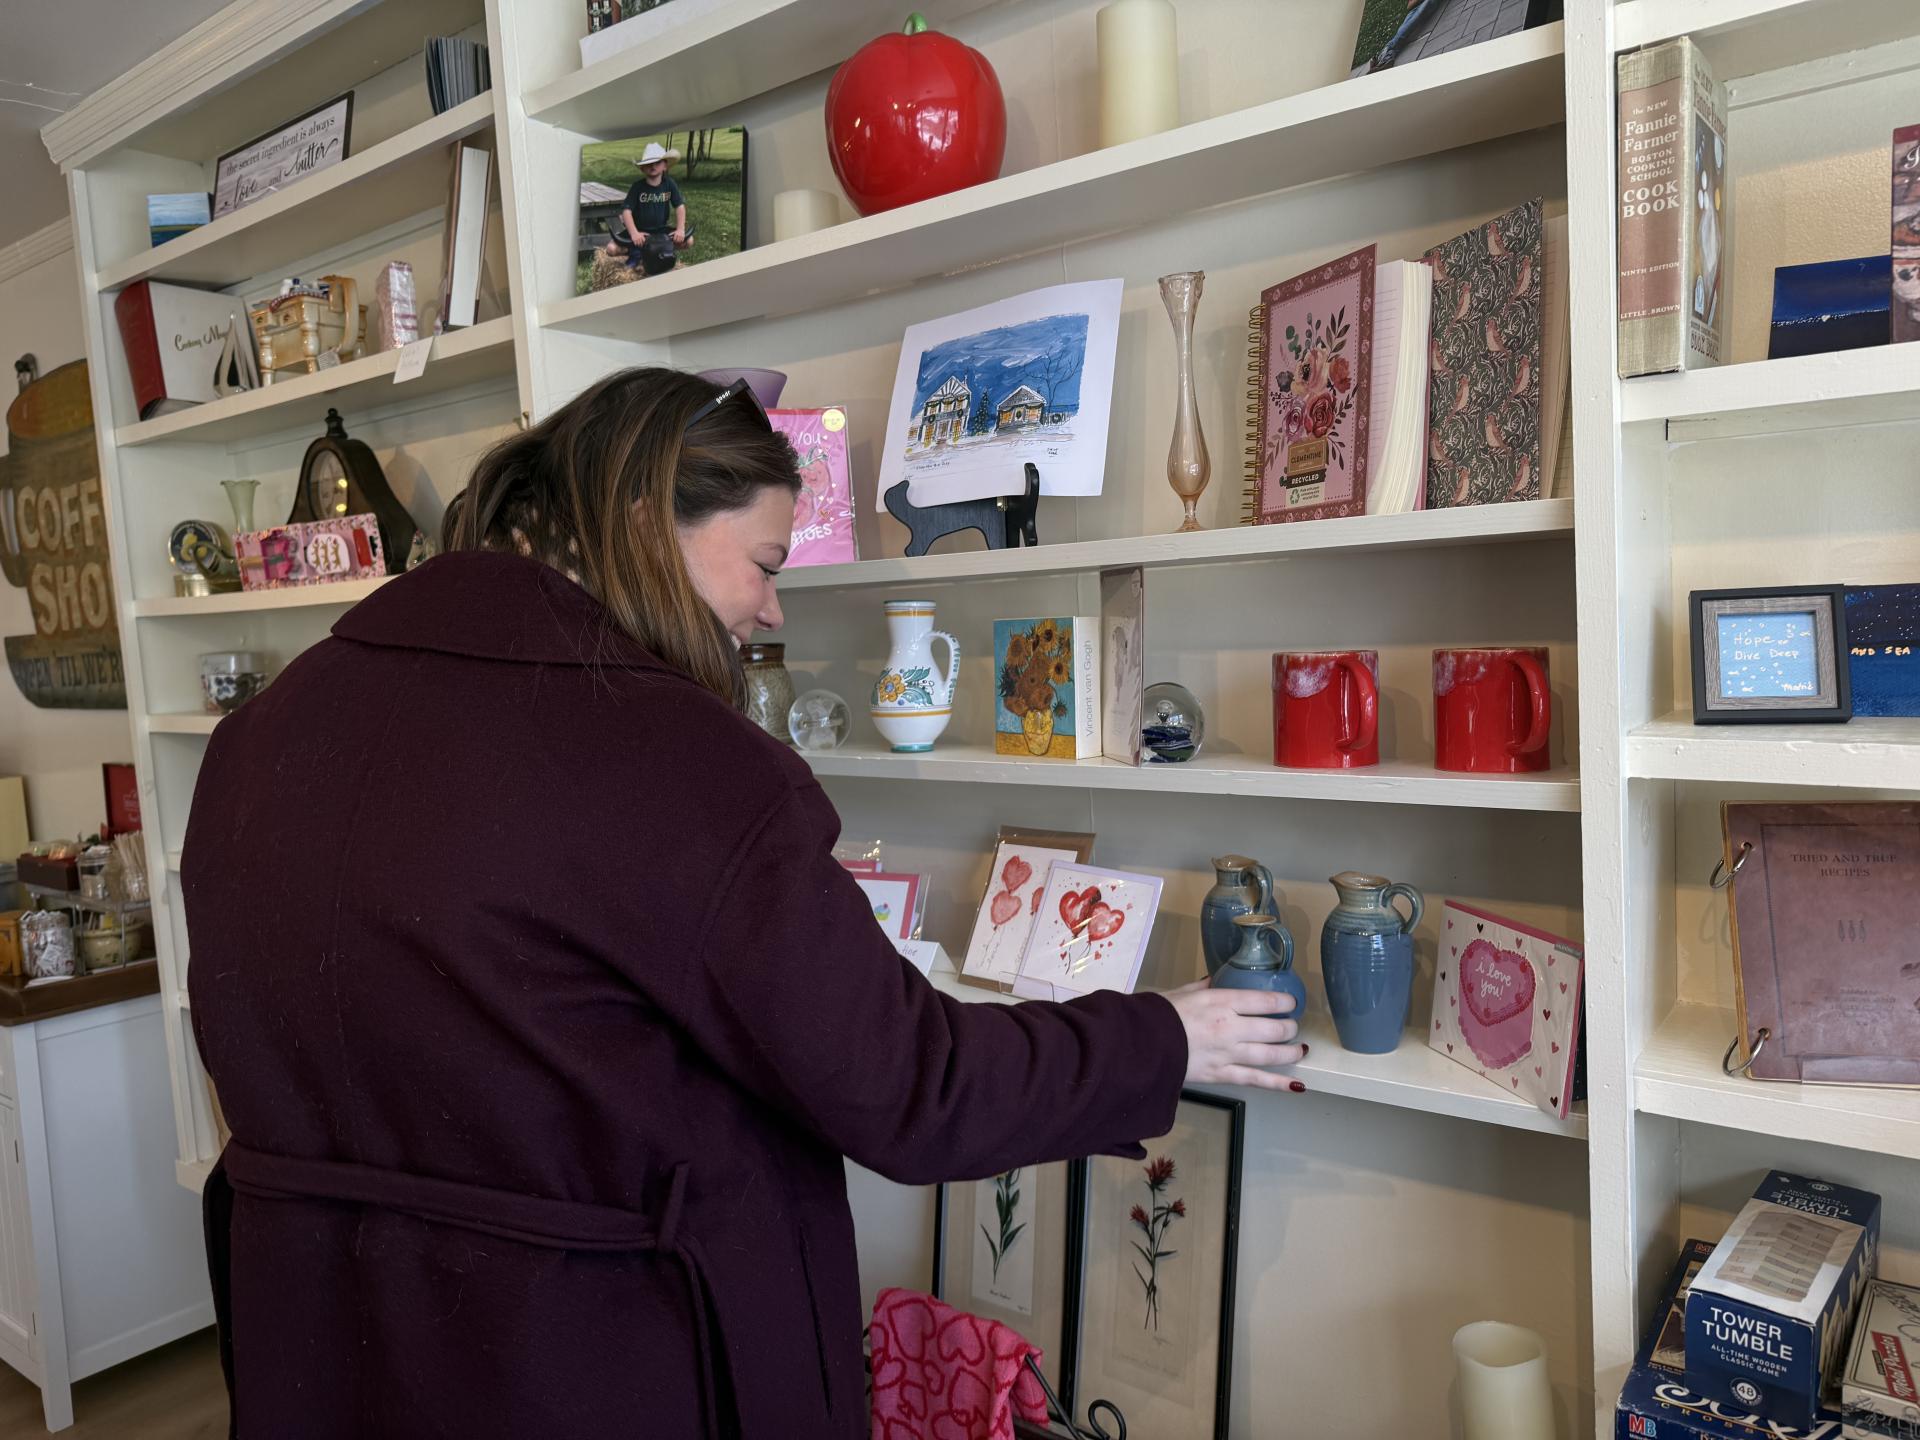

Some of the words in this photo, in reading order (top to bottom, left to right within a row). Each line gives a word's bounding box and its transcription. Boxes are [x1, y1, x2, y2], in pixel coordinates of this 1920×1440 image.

[1625, 112, 1677, 137] Fannie
[226, 162, 238, 176] the
[240, 152, 260, 169] secret
[261, 133, 299, 159] ingredient
[300, 127, 307, 141] is
[308, 116, 335, 137] always
[1624, 131, 1679, 153] Farmer
[284, 137, 339, 176] butter
[1627, 156, 1676, 174] COOKING
[1631, 147, 1673, 164] BOSTON
[1630, 166, 1673, 183] SCHOOL
[1623, 180, 1679, 203] COOK
[1623, 194, 1680, 218] BOOK
[1621, 268, 1647, 277] NINTH
[1649, 261, 1680, 273] EDITION
[1651, 304, 1680, 314] BROWN
[1291, 473, 1319, 484] RECYCLED
[17, 477, 100, 551] COFF
[31, 562, 110, 635] SHO
[1084, 640, 1092, 671] Gogh
[1735, 650, 1760, 660] Dive
[1769, 648, 1799, 660] Deep
[1850, 647, 1876, 657] AND
[1884, 645, 1911, 656] SEA
[1086, 697, 1094, 737] Vincent
[1791, 853, 1828, 863] TRIED
[1833, 853, 1860, 863] AND
[1820, 867, 1871, 878] RECIPES
[1487, 962, 1512, 987] love
[1480, 978, 1504, 1001] you!
[1710, 1306, 1782, 1342] TOWER
[1702, 1319, 1793, 1362] TUMBLE
[1711, 1343, 1750, 1361] ALL-TIME
[1751, 1356, 1788, 1373] WOODEN
[1720, 1354, 1755, 1369] CLASSIC
[1756, 1365, 1780, 1378] GAME
[1738, 1385, 1755, 1397] 48
[1629, 1413, 1657, 1438] MB
